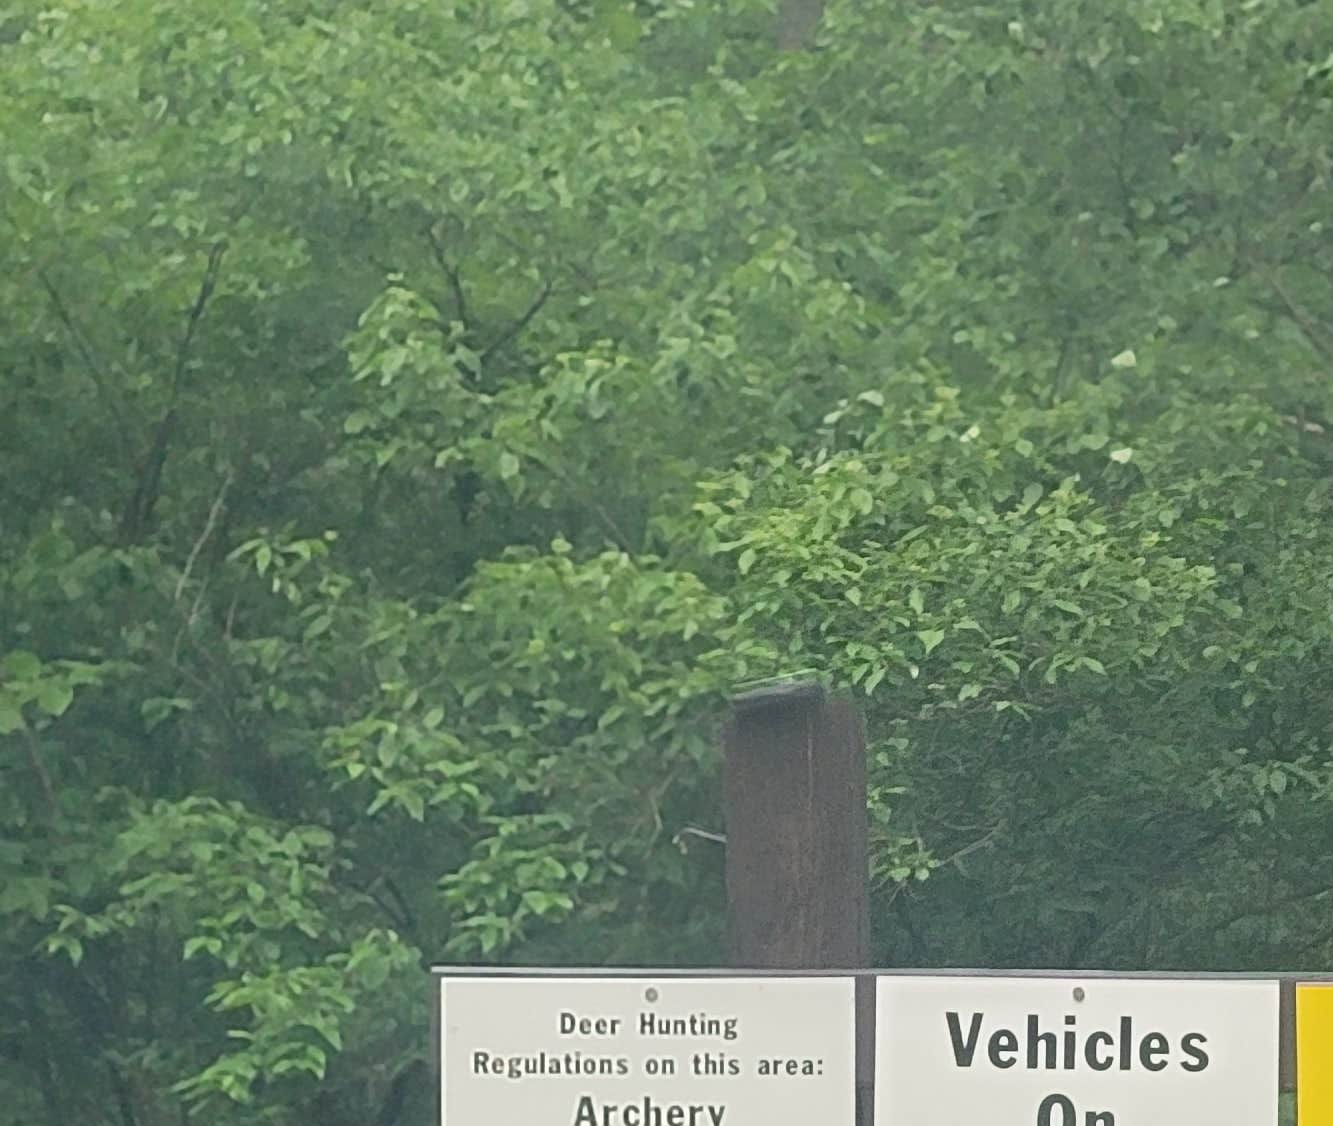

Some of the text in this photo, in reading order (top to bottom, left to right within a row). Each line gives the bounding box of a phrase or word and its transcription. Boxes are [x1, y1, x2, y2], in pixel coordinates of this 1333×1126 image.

[560, 1012, 738, 1041] Deer Hunting
[945, 1011, 1210, 1073] Vehicles
[473, 1051, 823, 1079] Regulations on this area:
